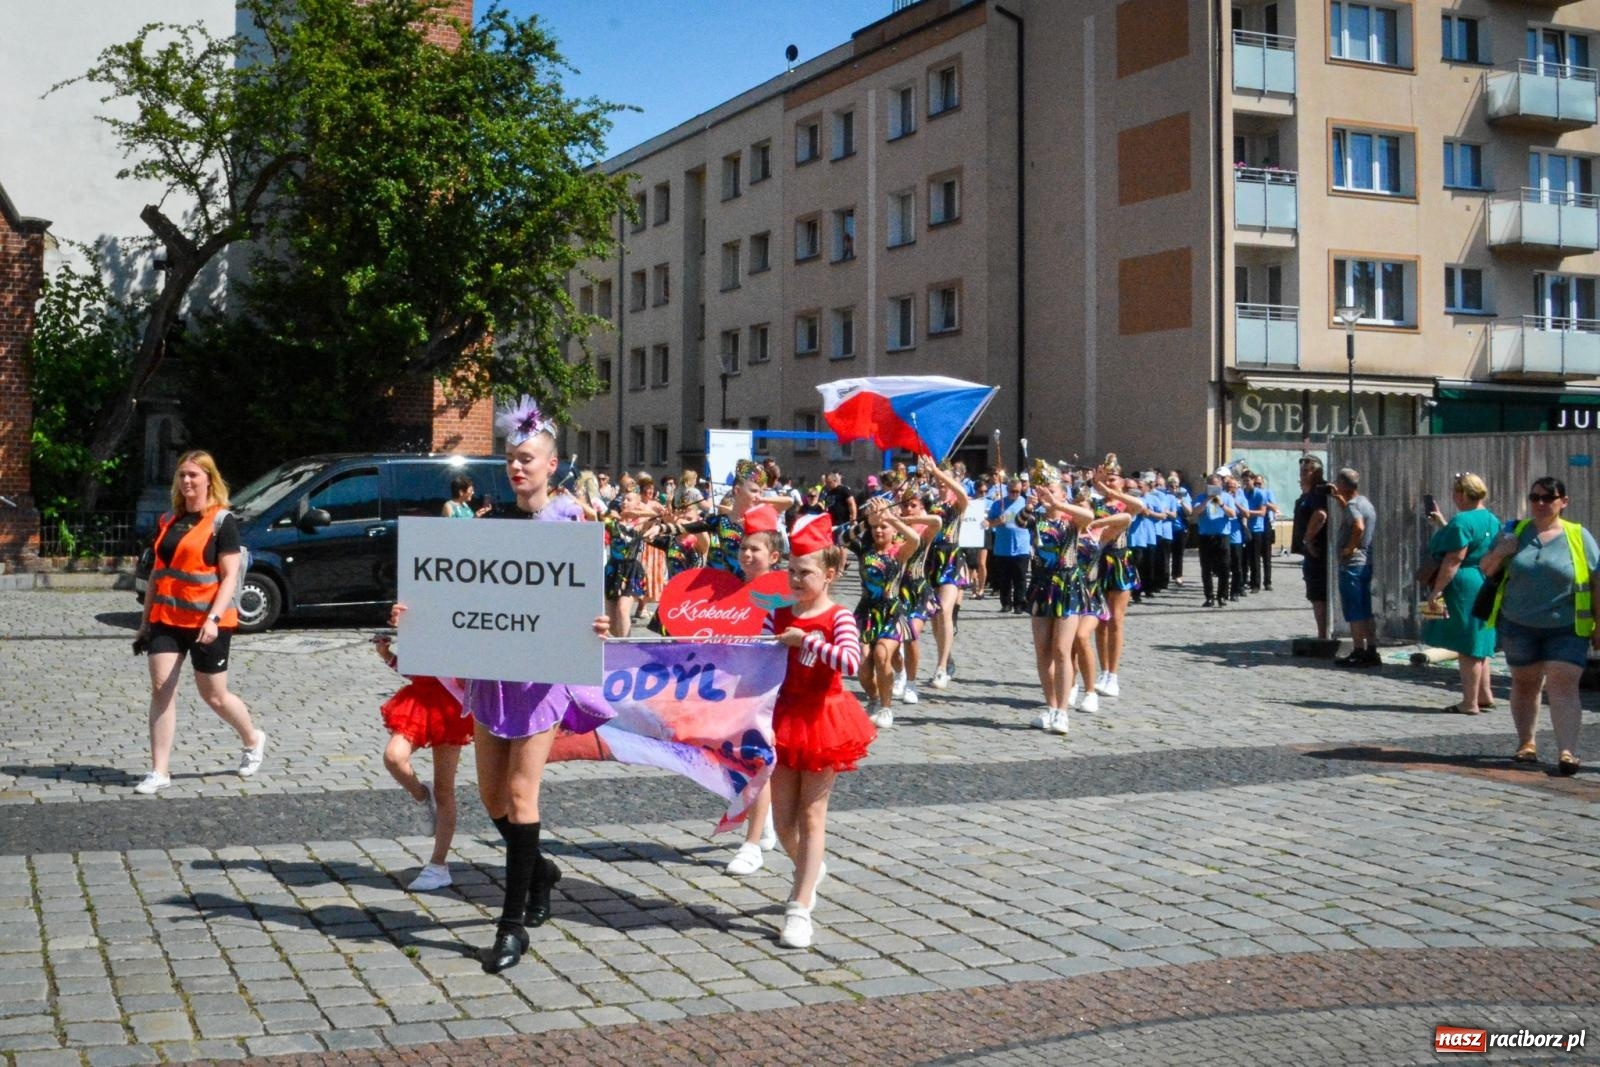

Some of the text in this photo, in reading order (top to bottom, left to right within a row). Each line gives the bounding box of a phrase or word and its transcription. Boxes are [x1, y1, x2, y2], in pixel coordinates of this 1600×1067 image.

[414, 556, 586, 588] KROKODYL
[452, 611, 541, 632] CZECHY
[603, 652, 726, 703] ODÝL
